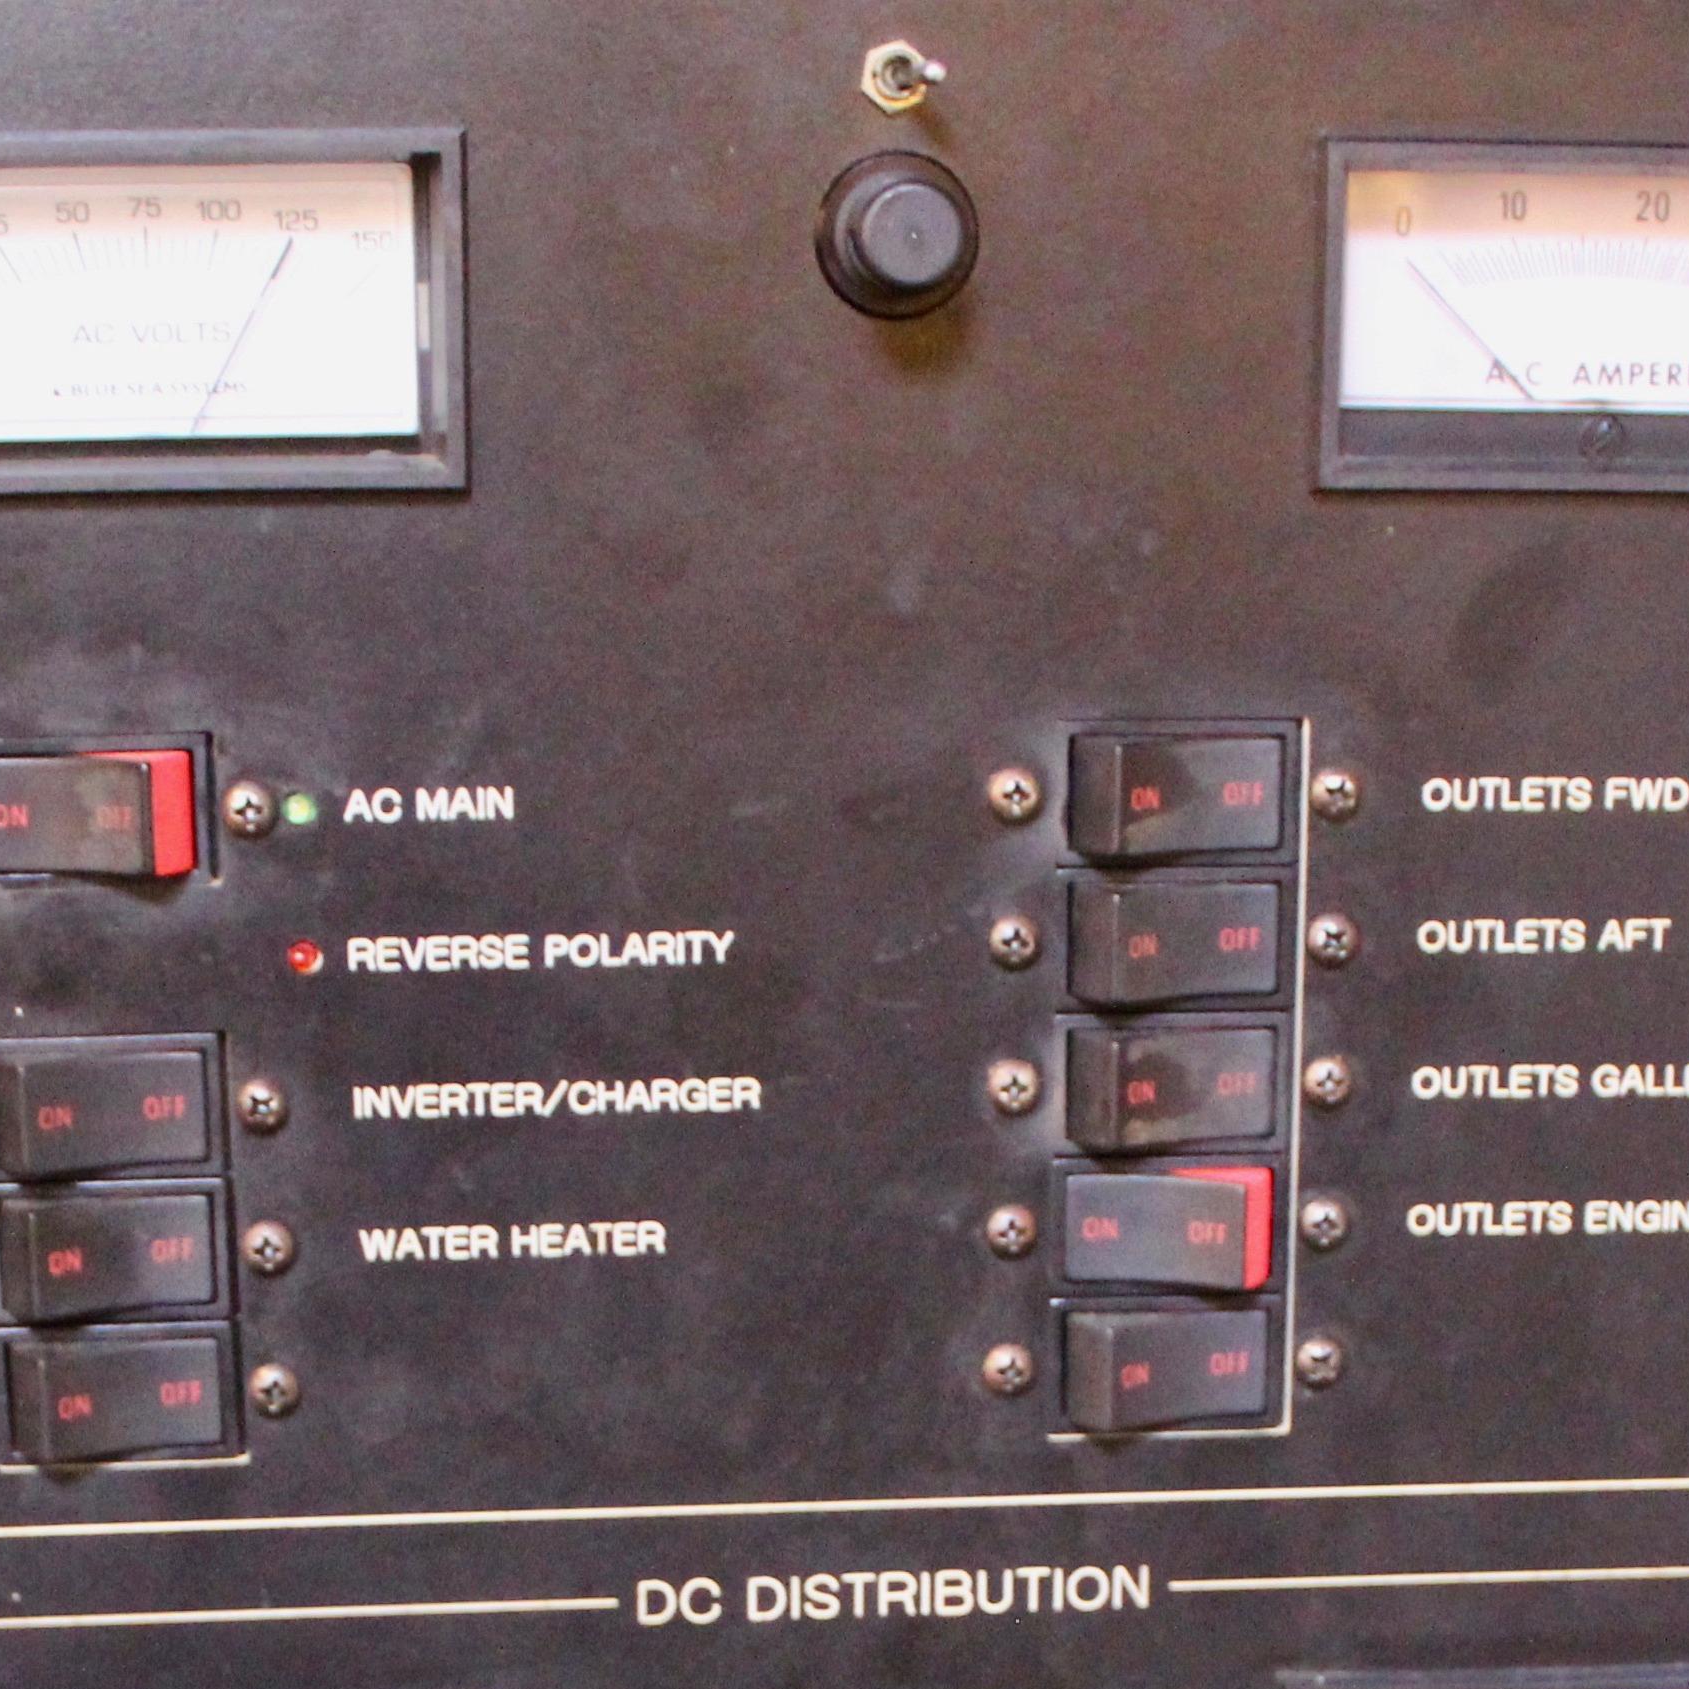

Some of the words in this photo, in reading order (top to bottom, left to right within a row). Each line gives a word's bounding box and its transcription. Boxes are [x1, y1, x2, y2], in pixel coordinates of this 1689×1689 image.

[54, 200, 91, 225] 50
[127, 197, 163, 221] 75
[195, 199, 243, 222] 100
[273, 208, 319, 232] 125
[1500, 191, 1528, 221] 10
[1635, 190, 1671, 222] 20
[130, 321, 232, 345] VOLTS
[342, 787, 403, 824] AC
[415, 785, 515, 822] MAIN
[1131, 786, 1162, 810] ON
[1221, 781, 1264, 806] OFF
[1421, 776, 1593, 813] OUTLETS
[346, 933, 531, 973] REVERSE
[543, 930, 735, 969] POLARITY
[1128, 933, 1160, 960] ON
[1218, 926, 1261, 952] OFF
[1416, 918, 1587, 954] OUTLETS
[1597, 917, 1672, 952] AFT
[352, 1076, 762, 1120] INVERTER/CHARGER
[1126, 1080, 1157, 1105] ON
[1215, 1072, 1257, 1098] OFF
[1410, 1063, 1580, 1100] OUTLETS
[37, 1104, 75, 1132] ON
[142, 1094, 187, 1122] OFF
[1081, 1216, 1120, 1242] ON
[1188, 1221, 1229, 1245] OFF
[1406, 1200, 1573, 1237] OUTLETS
[47, 1249, 84, 1277] ON
[150, 1236, 194, 1264] OFF
[358, 1224, 500, 1263] WATER
[510, 1220, 667, 1259] HEATER
[1120, 1363, 1152, 1388] ON
[1208, 1352, 1249, 1376] OFF
[57, 1393, 94, 1421] ON
[159, 1379, 203, 1407] OFF
[636, 1576, 723, 1626] DC
[746, 1564, 1150, 1623] DISTRIBUTION
